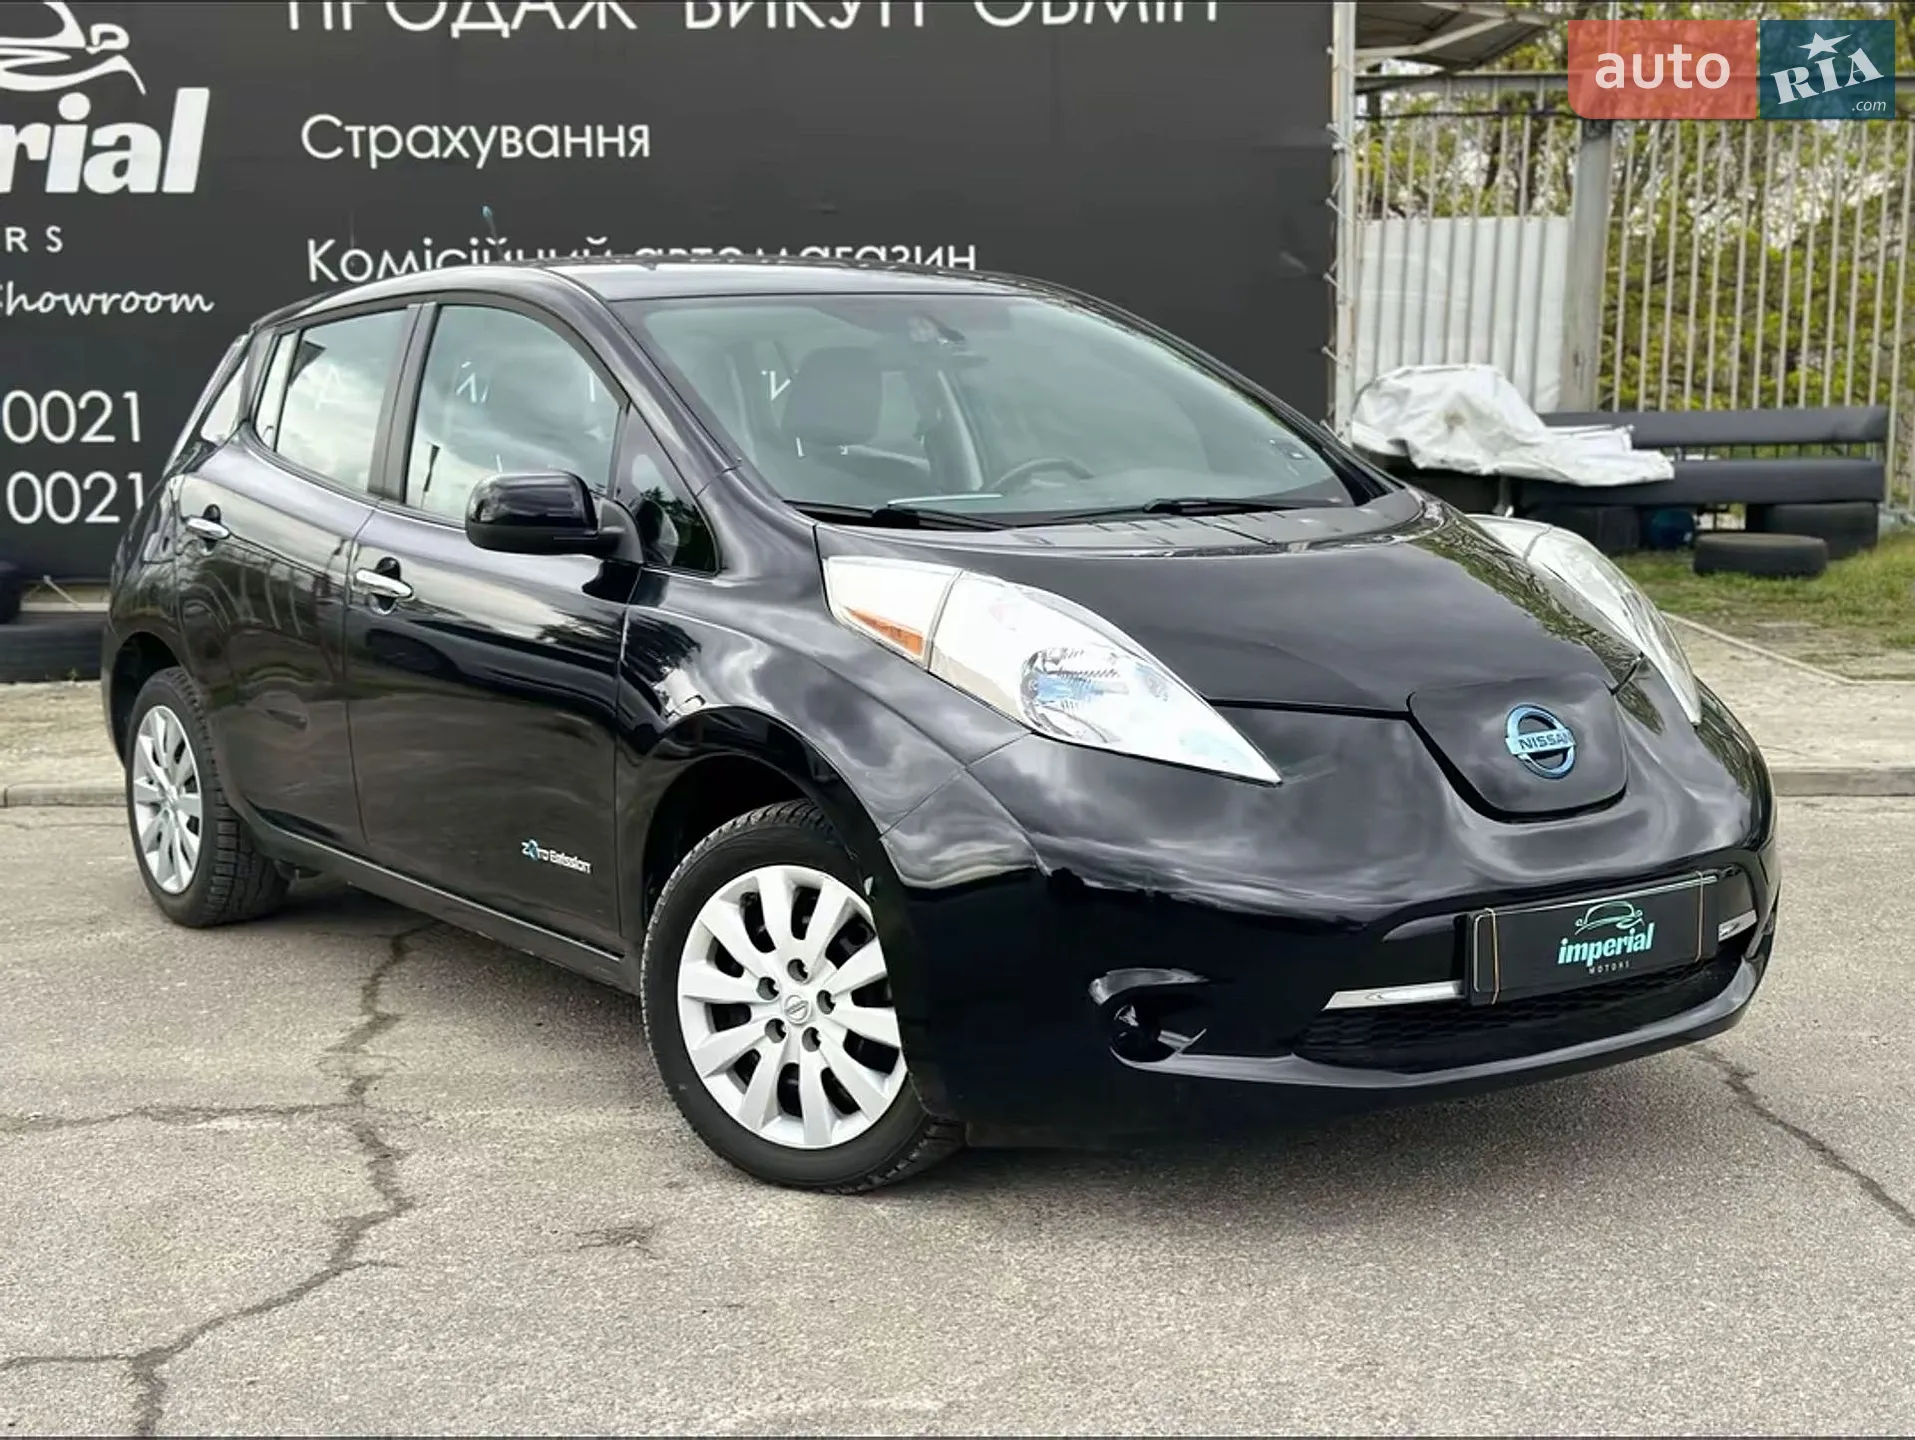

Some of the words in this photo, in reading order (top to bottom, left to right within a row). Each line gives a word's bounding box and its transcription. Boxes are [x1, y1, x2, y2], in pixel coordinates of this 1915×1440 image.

[301, 113, 651, 170] Страхування
[0, 280, 216, 317] howroom
[1, 389, 141, 445] 0021
[6, 470, 145, 525] 0021
[1557, 921, 1656, 968] imperial
[1588, 959, 1631, 975] MOTORS
